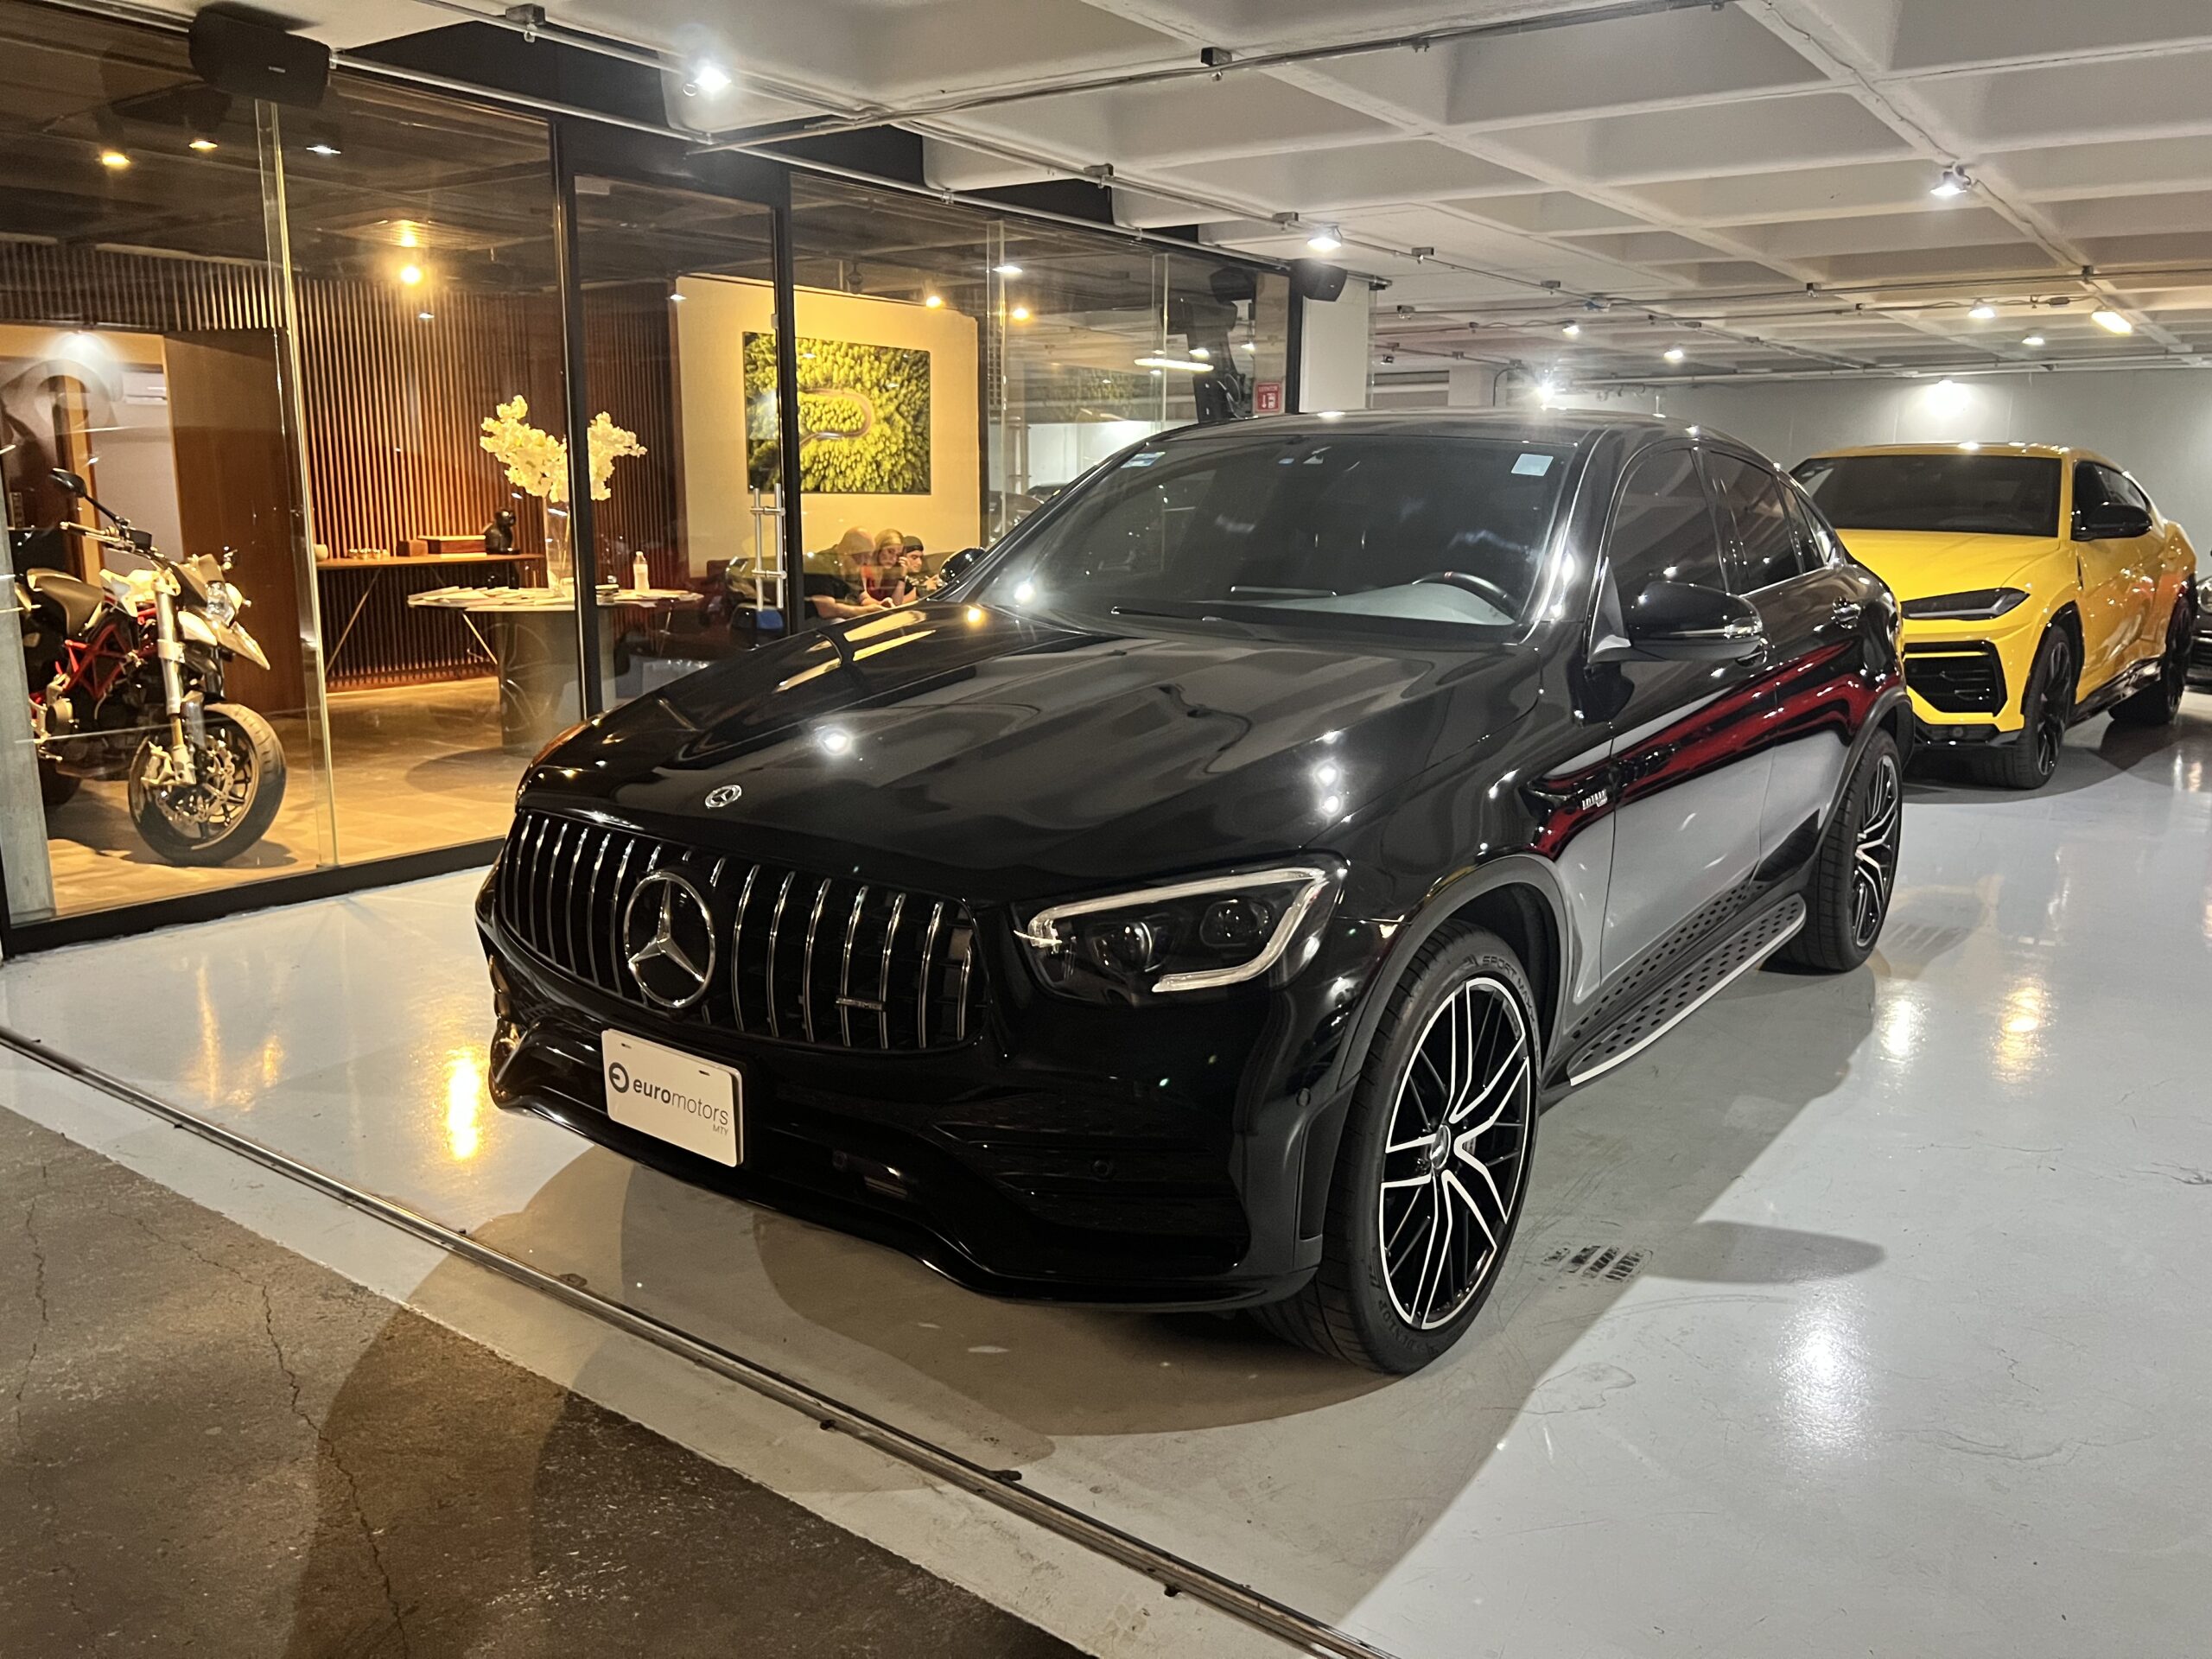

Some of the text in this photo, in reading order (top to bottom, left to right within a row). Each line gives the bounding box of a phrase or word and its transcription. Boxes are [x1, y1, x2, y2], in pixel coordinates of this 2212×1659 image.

[1483, 956, 1517, 977] SPORT
[632, 1078, 728, 1125] euromotors
[713, 1124, 728, 1135] MTY
